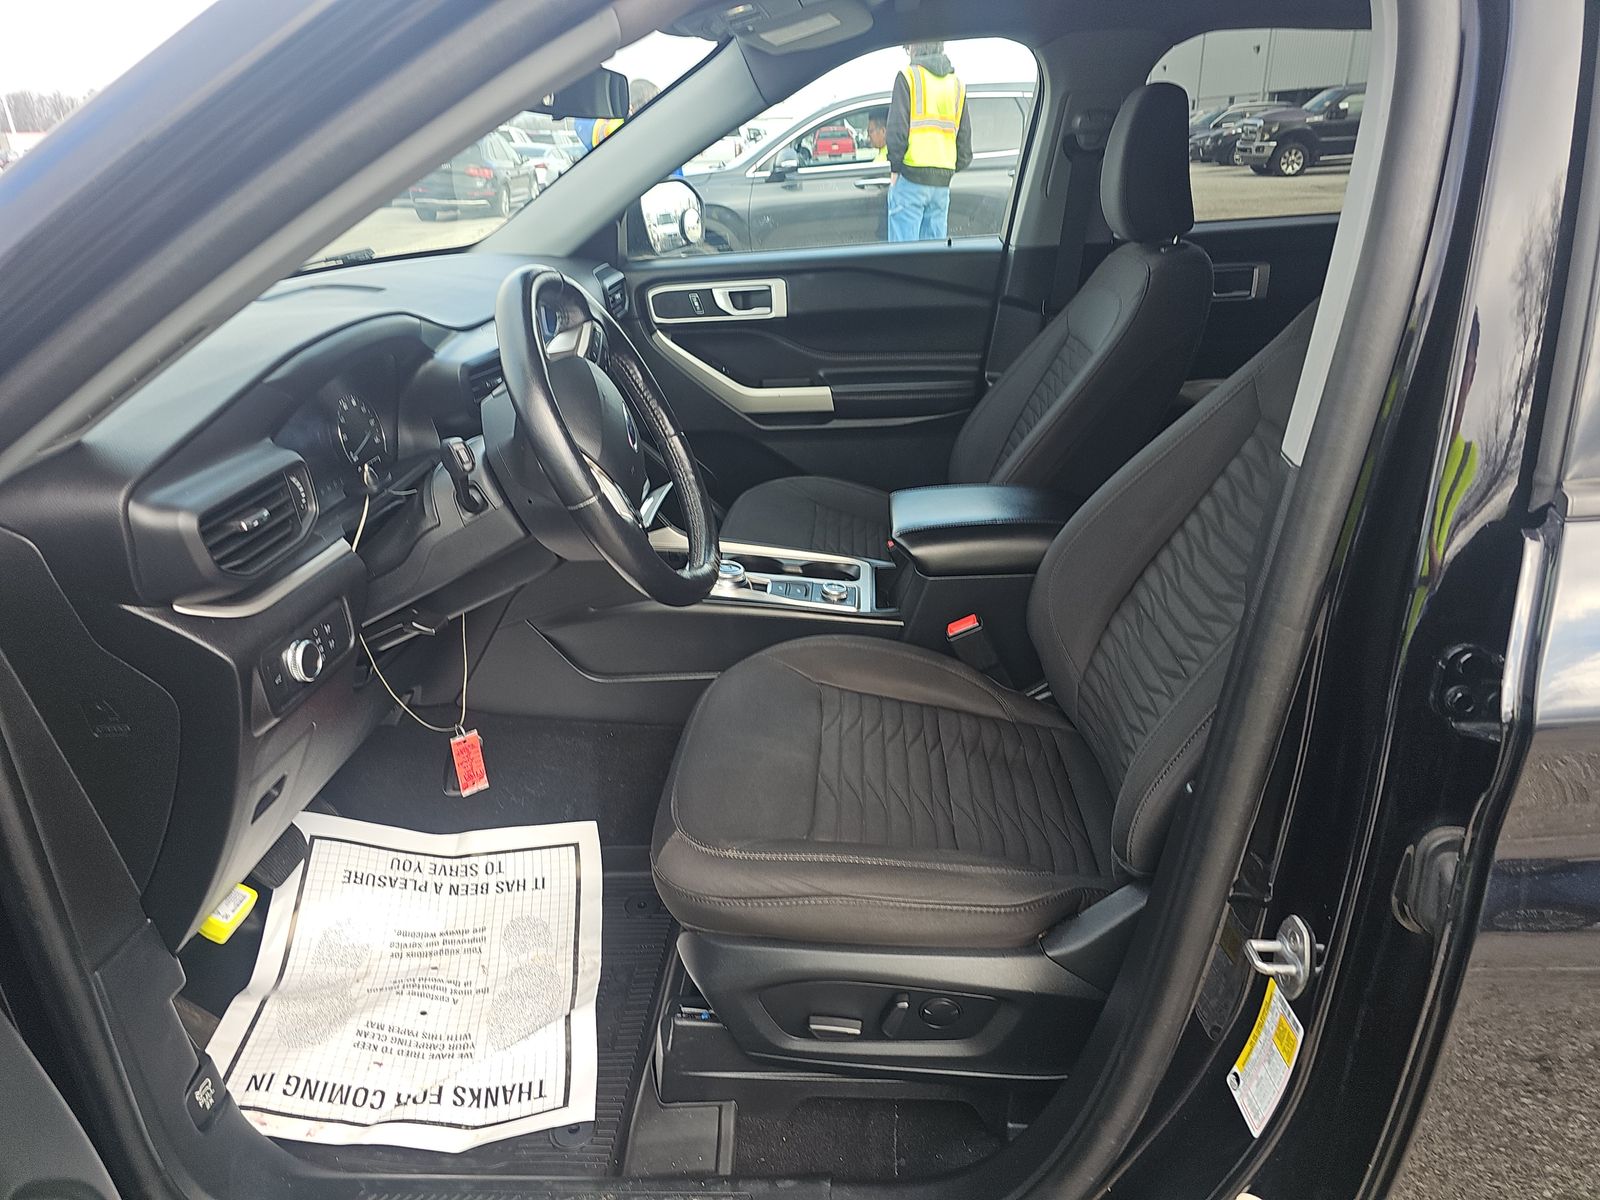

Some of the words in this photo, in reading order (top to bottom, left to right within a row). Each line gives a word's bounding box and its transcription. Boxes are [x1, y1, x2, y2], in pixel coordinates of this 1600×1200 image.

[390, 857, 423, 874] YOU
[428, 862, 478, 877] SERVE
[485, 861, 504, 876] TO
[341, 869, 428, 892] PLEASURE
[495, 879, 526, 894] HAS
[532, 877, 545, 891] IT
[433, 882, 443, 895] A
[449, 882, 489, 896] BEEN
[389, 941, 422, 949] service
[442, 935, 486, 945] improving
[390, 952, 403, 960] for
[406, 948, 460, 959] suggestions
[463, 946, 482, 954] Your
[406, 990, 450, 1003] customer
[452, 997, 458, 1005] A
[365, 1020, 385, 1031] MAT
[388, 1025, 418, 1037] PAPER
[356, 1029, 388, 1044] CLEAN
[390, 1036, 445, 1050] CARPETING
[421, 1032, 442, 1041] THIS
[446, 1033, 471, 1041] WITH
[353, 1040, 378, 1053] KEEP
[382, 1046, 393, 1054] TO
[448, 1042, 475, 1051] YOUR
[397, 1049, 425, 1059] TRIED
[428, 1052, 454, 1060] HAVE
[244, 1072, 275, 1093] IN
[282, 1074, 386, 1110] COMING
[452, 1079, 547, 1108] THANKS
